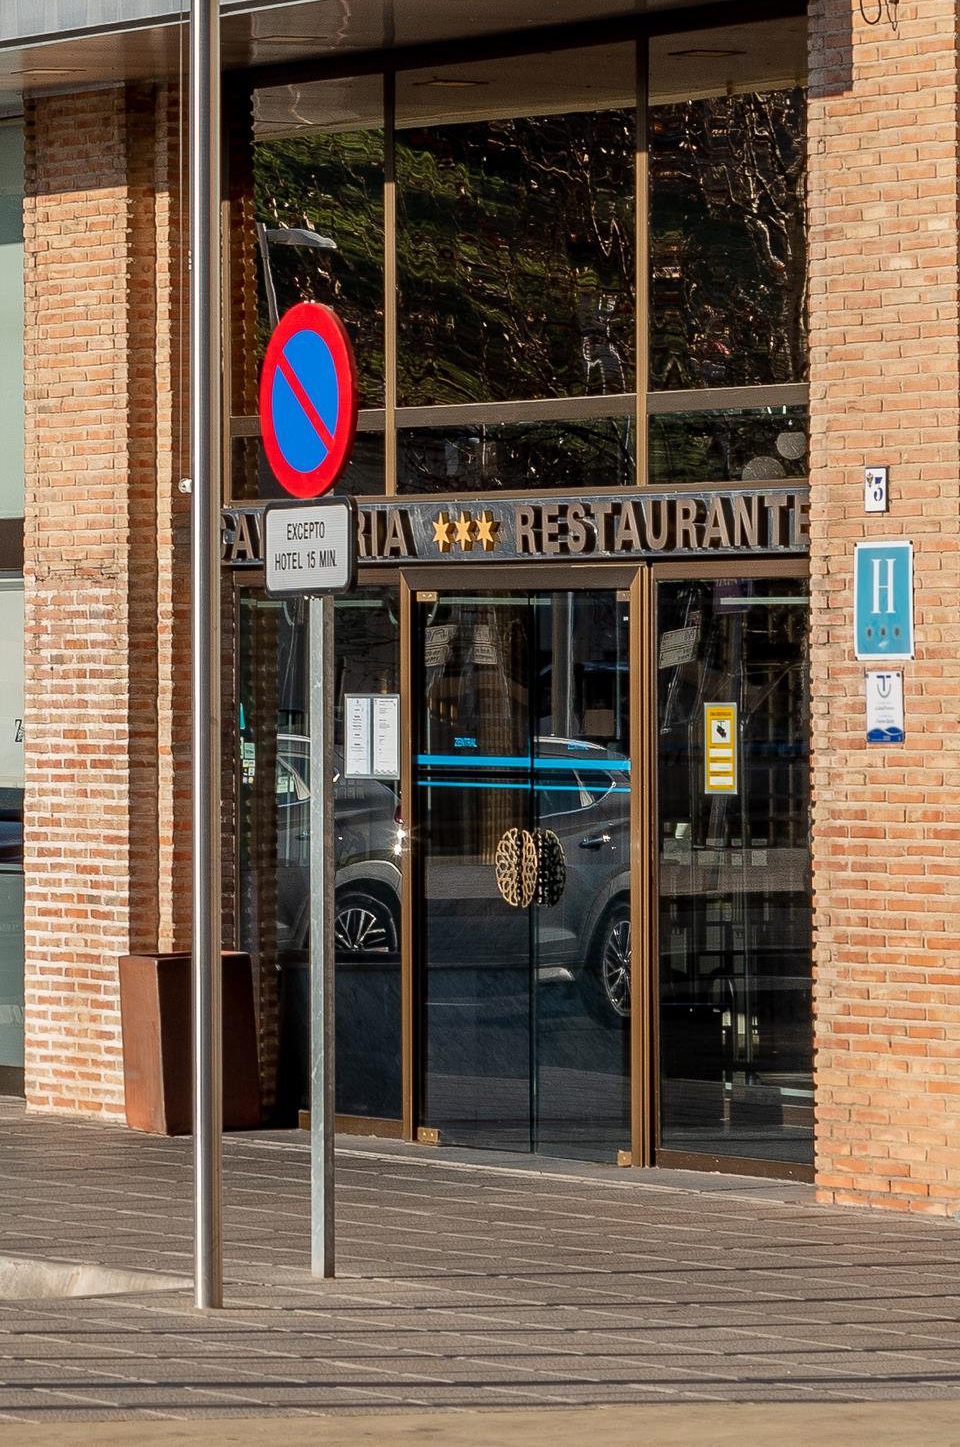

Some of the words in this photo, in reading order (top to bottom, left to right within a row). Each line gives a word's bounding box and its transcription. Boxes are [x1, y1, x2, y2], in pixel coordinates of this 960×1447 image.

[874, 476, 884, 502] 5
[287, 521, 325, 541] EXCEPTO
[515, 495, 809, 554] RESTAURANTE
[275, 552, 303, 571] HOTEL
[307, 551, 316, 569] 15
[871, 558, 897, 614] H
